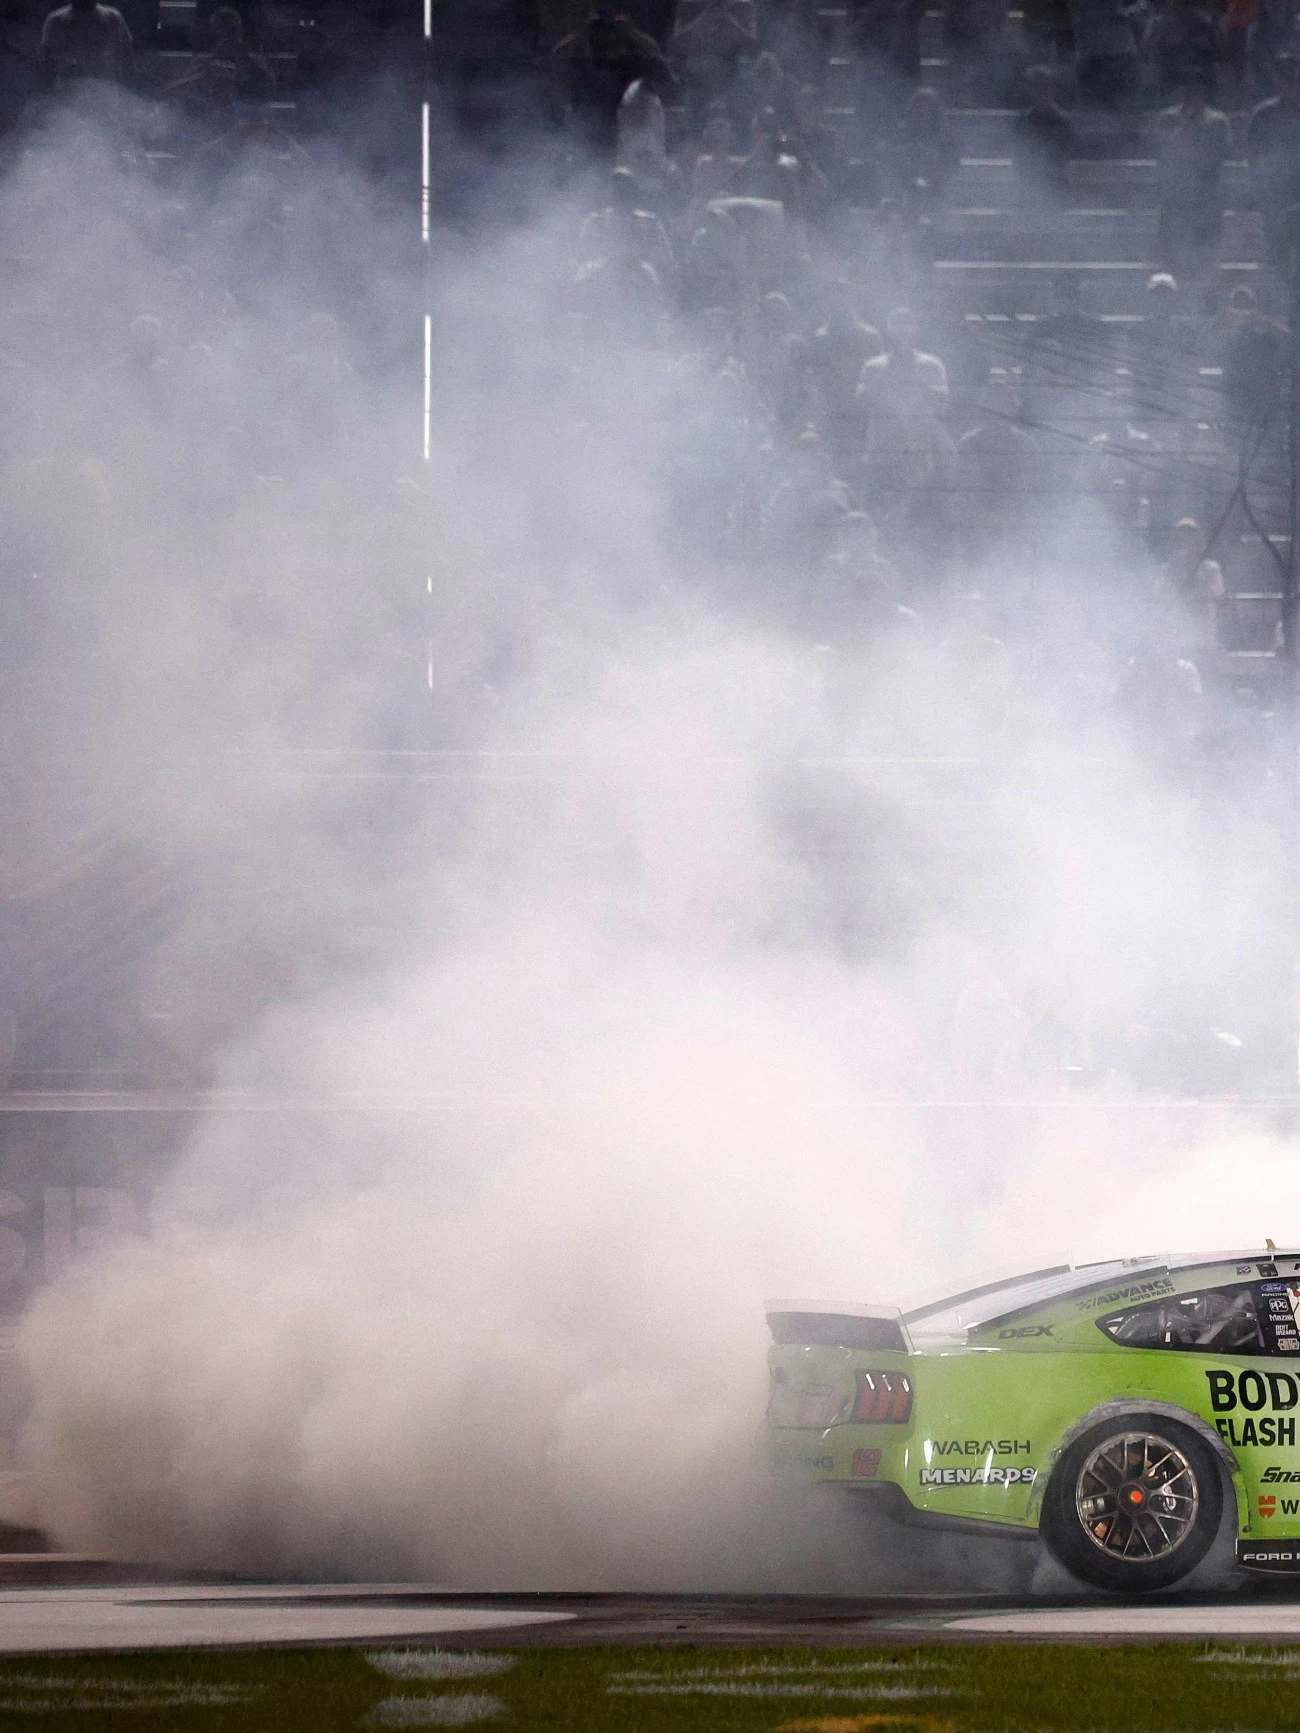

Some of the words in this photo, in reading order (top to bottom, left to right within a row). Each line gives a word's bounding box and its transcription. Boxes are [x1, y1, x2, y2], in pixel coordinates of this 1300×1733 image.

[1096, 1278, 1174, 1305] ADVANCE
[1130, 1291, 1150, 1302] AUTO
[1151, 1286, 1177, 1297] PARTS
[1270, 1300, 1288, 1311] PPG
[1269, 1314, 1294, 1322] Mazak
[998, 1324, 1054, 1340] DEX
[1215, 1417, 1295, 1447] FLASH
[931, 1440, 1031, 1455] WABASH
[852, 1448, 882, 1477] 12
[920, 1467, 1038, 1484] MENARDS
[1243, 1553, 1293, 1562] FORD
